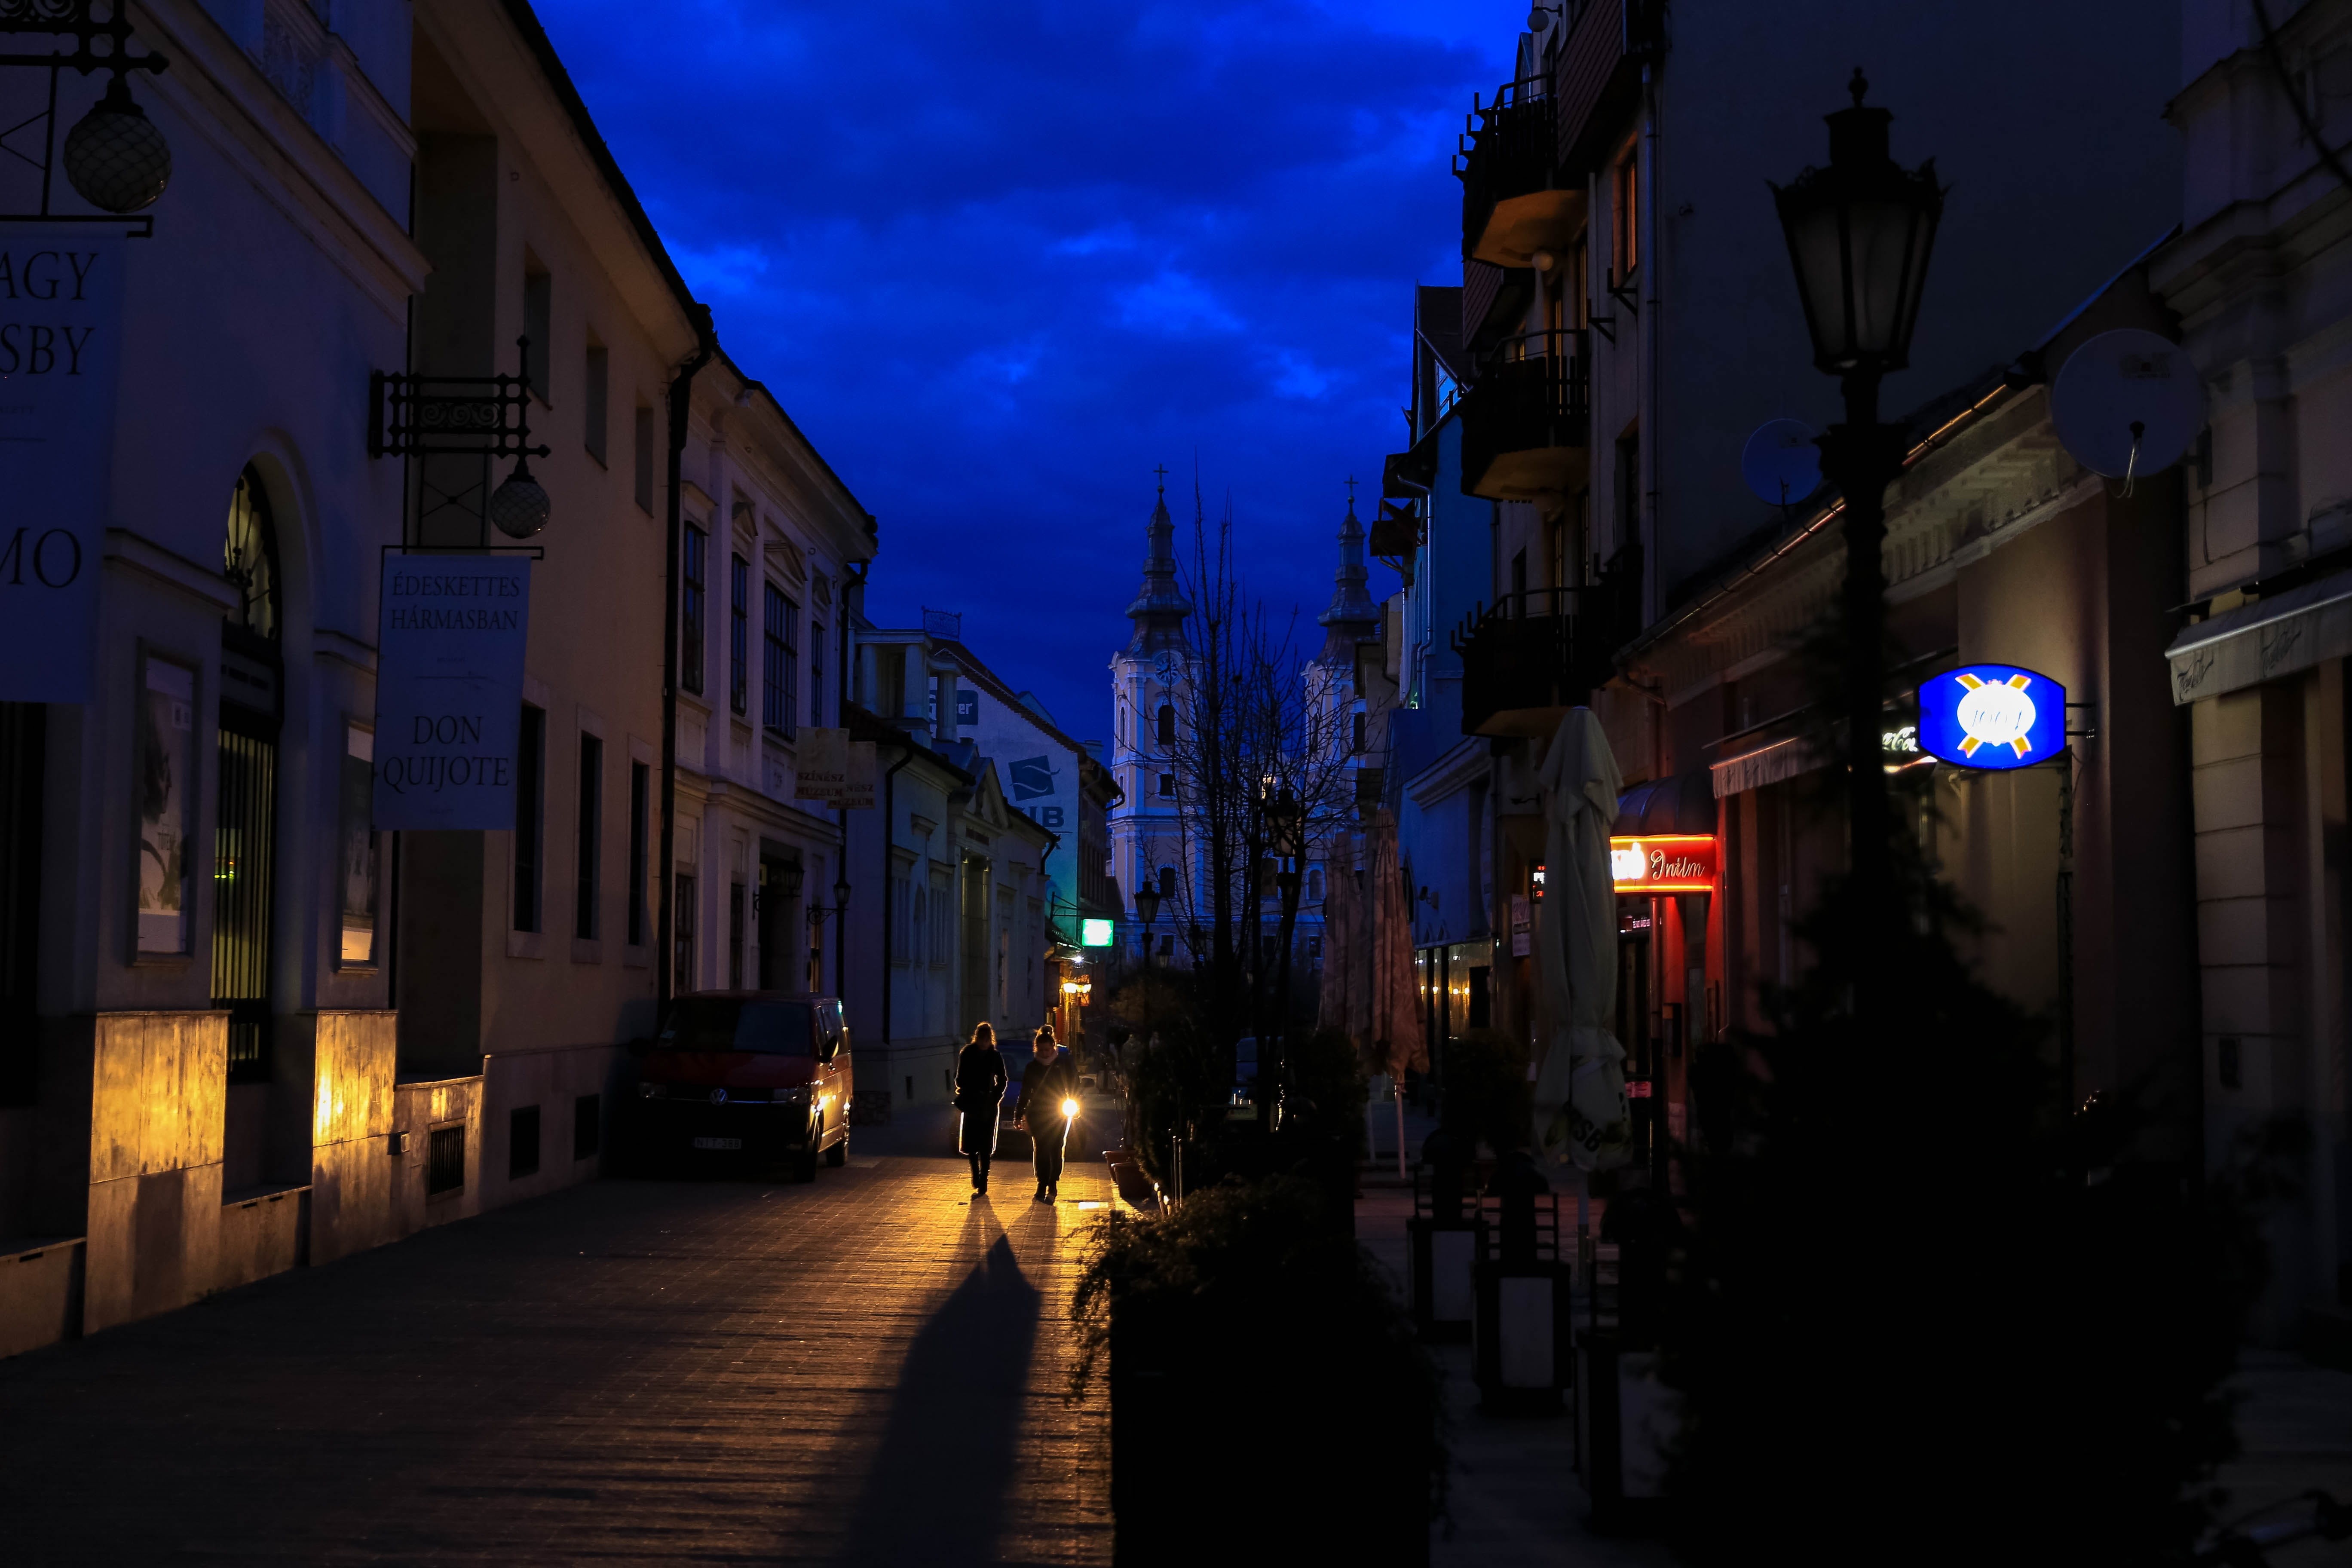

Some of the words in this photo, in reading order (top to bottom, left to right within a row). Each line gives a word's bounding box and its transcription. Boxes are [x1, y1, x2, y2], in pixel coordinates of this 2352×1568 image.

[392, 572, 520, 597] ÉDESKETTES
[390, 605, 518, 630] HÁRMASBAN
[413, 715, 483, 745] DON
[383, 756, 509, 794] QUIJOTE
[797, 770, 845, 782] SZÍNÉSZ
[845, 781, 874, 792] NÉSZ
